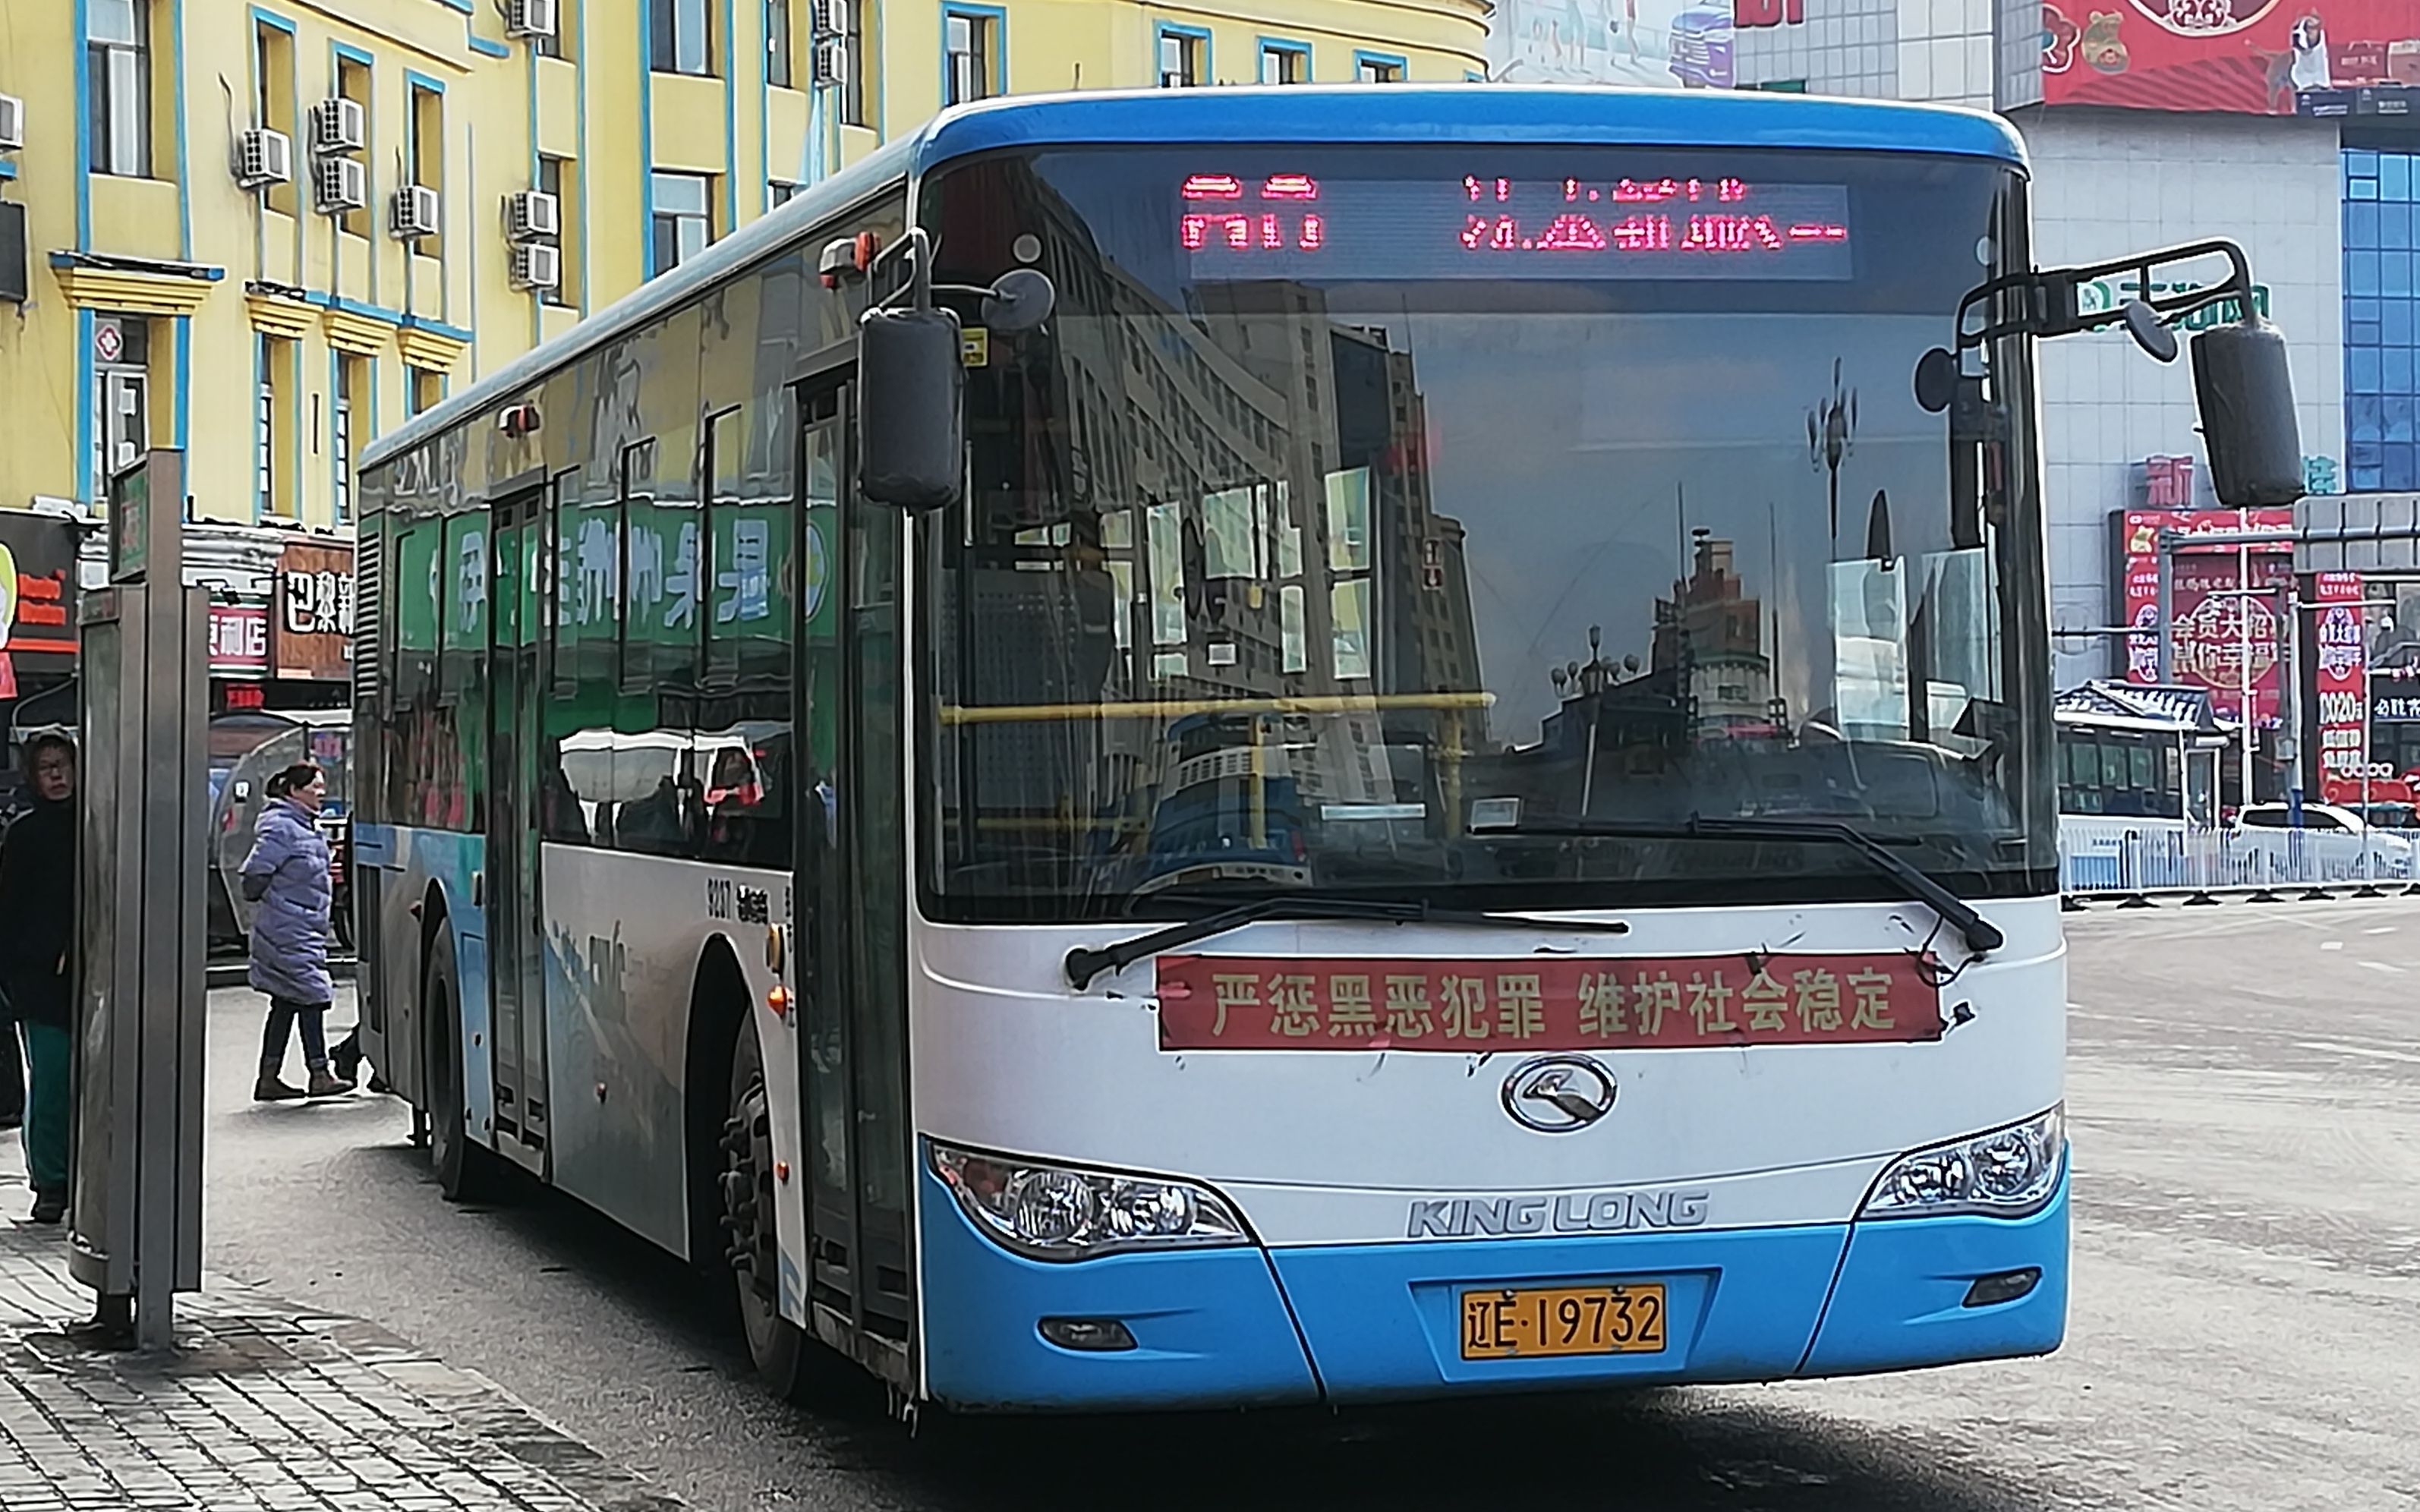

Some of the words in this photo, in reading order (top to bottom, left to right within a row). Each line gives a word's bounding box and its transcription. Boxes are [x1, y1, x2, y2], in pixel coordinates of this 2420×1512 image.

[2145, 455, 2195, 506] 新
[1212, 972, 1546, 1040] 严惩黑恶犯罪
[1577, 969, 1897, 1039] 维护社会稳定
[1407, 1195, 1550, 1240] KING
[1551, 1189, 1710, 1232] LONG
